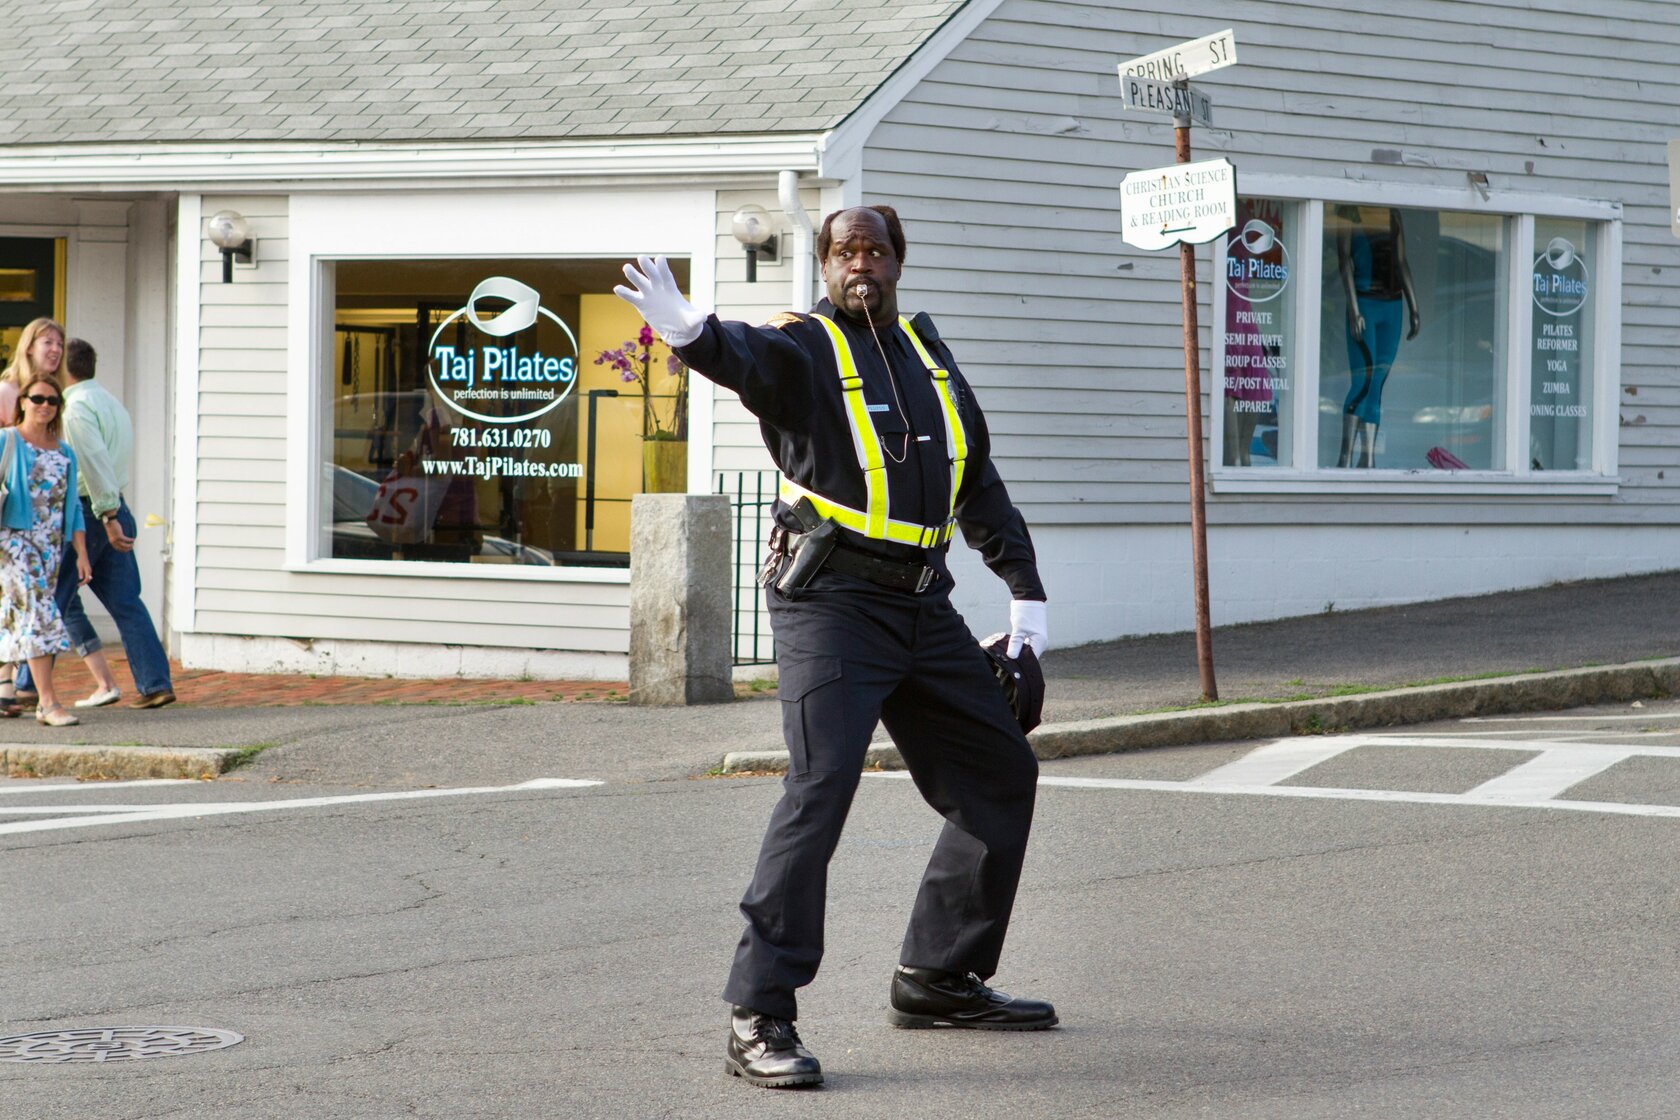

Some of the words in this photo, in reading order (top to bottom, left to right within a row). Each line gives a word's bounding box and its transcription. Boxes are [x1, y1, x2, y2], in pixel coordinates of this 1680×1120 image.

[1209, 38, 1228, 65] ST
[1130, 82, 1196, 115] PLEASANT
[1201, 97, 1210, 122] ST
[1126, 175, 1181, 196] CHRISTIAN
[1185, 168, 1228, 187] SCIENCE
[1149, 188, 1205, 208] CHURCH
[1130, 214, 1139, 228] &
[1142, 206, 1191, 226] READING
[1194, 201, 1228, 219] ROOM
[1227, 257, 1245, 281] Taj
[1248, 258, 1288, 279] Pilates
[1534, 273, 1549, 296] Taj
[1552, 274, 1588, 294] Pilates
[1236, 311, 1272, 324] PRIVATE
[1543, 324, 1573, 337] PILATES
[1224, 333, 1246, 345] SEMI
[1247, 334, 1283, 346] PRIVATE
[1537, 338, 1578, 351] REFORMER
[435, 346, 475, 387] Taj
[482, 346, 573, 382] Pilates
[1225, 355, 1250, 368] ROUP
[1251, 356, 1286, 368] CLASSES
[1547, 359, 1568, 372] YOGA
[1224, 376, 1261, 391] RE/POST
[1263, 378, 1289, 390] NATAL
[1543, 382, 1570, 394] ZUMBA
[454, 387, 499, 400] perfection
[501, 388, 509, 399] is
[511, 387, 554, 400] unlimited
[1233, 400, 1272, 413] APPAREL
[1531, 404, 1555, 416] ONING
[1556, 404, 1587, 417] CLASSES
[450, 427, 551, 448] 781.631.0270
[422, 456, 583, 480] www.TajPilates.com
